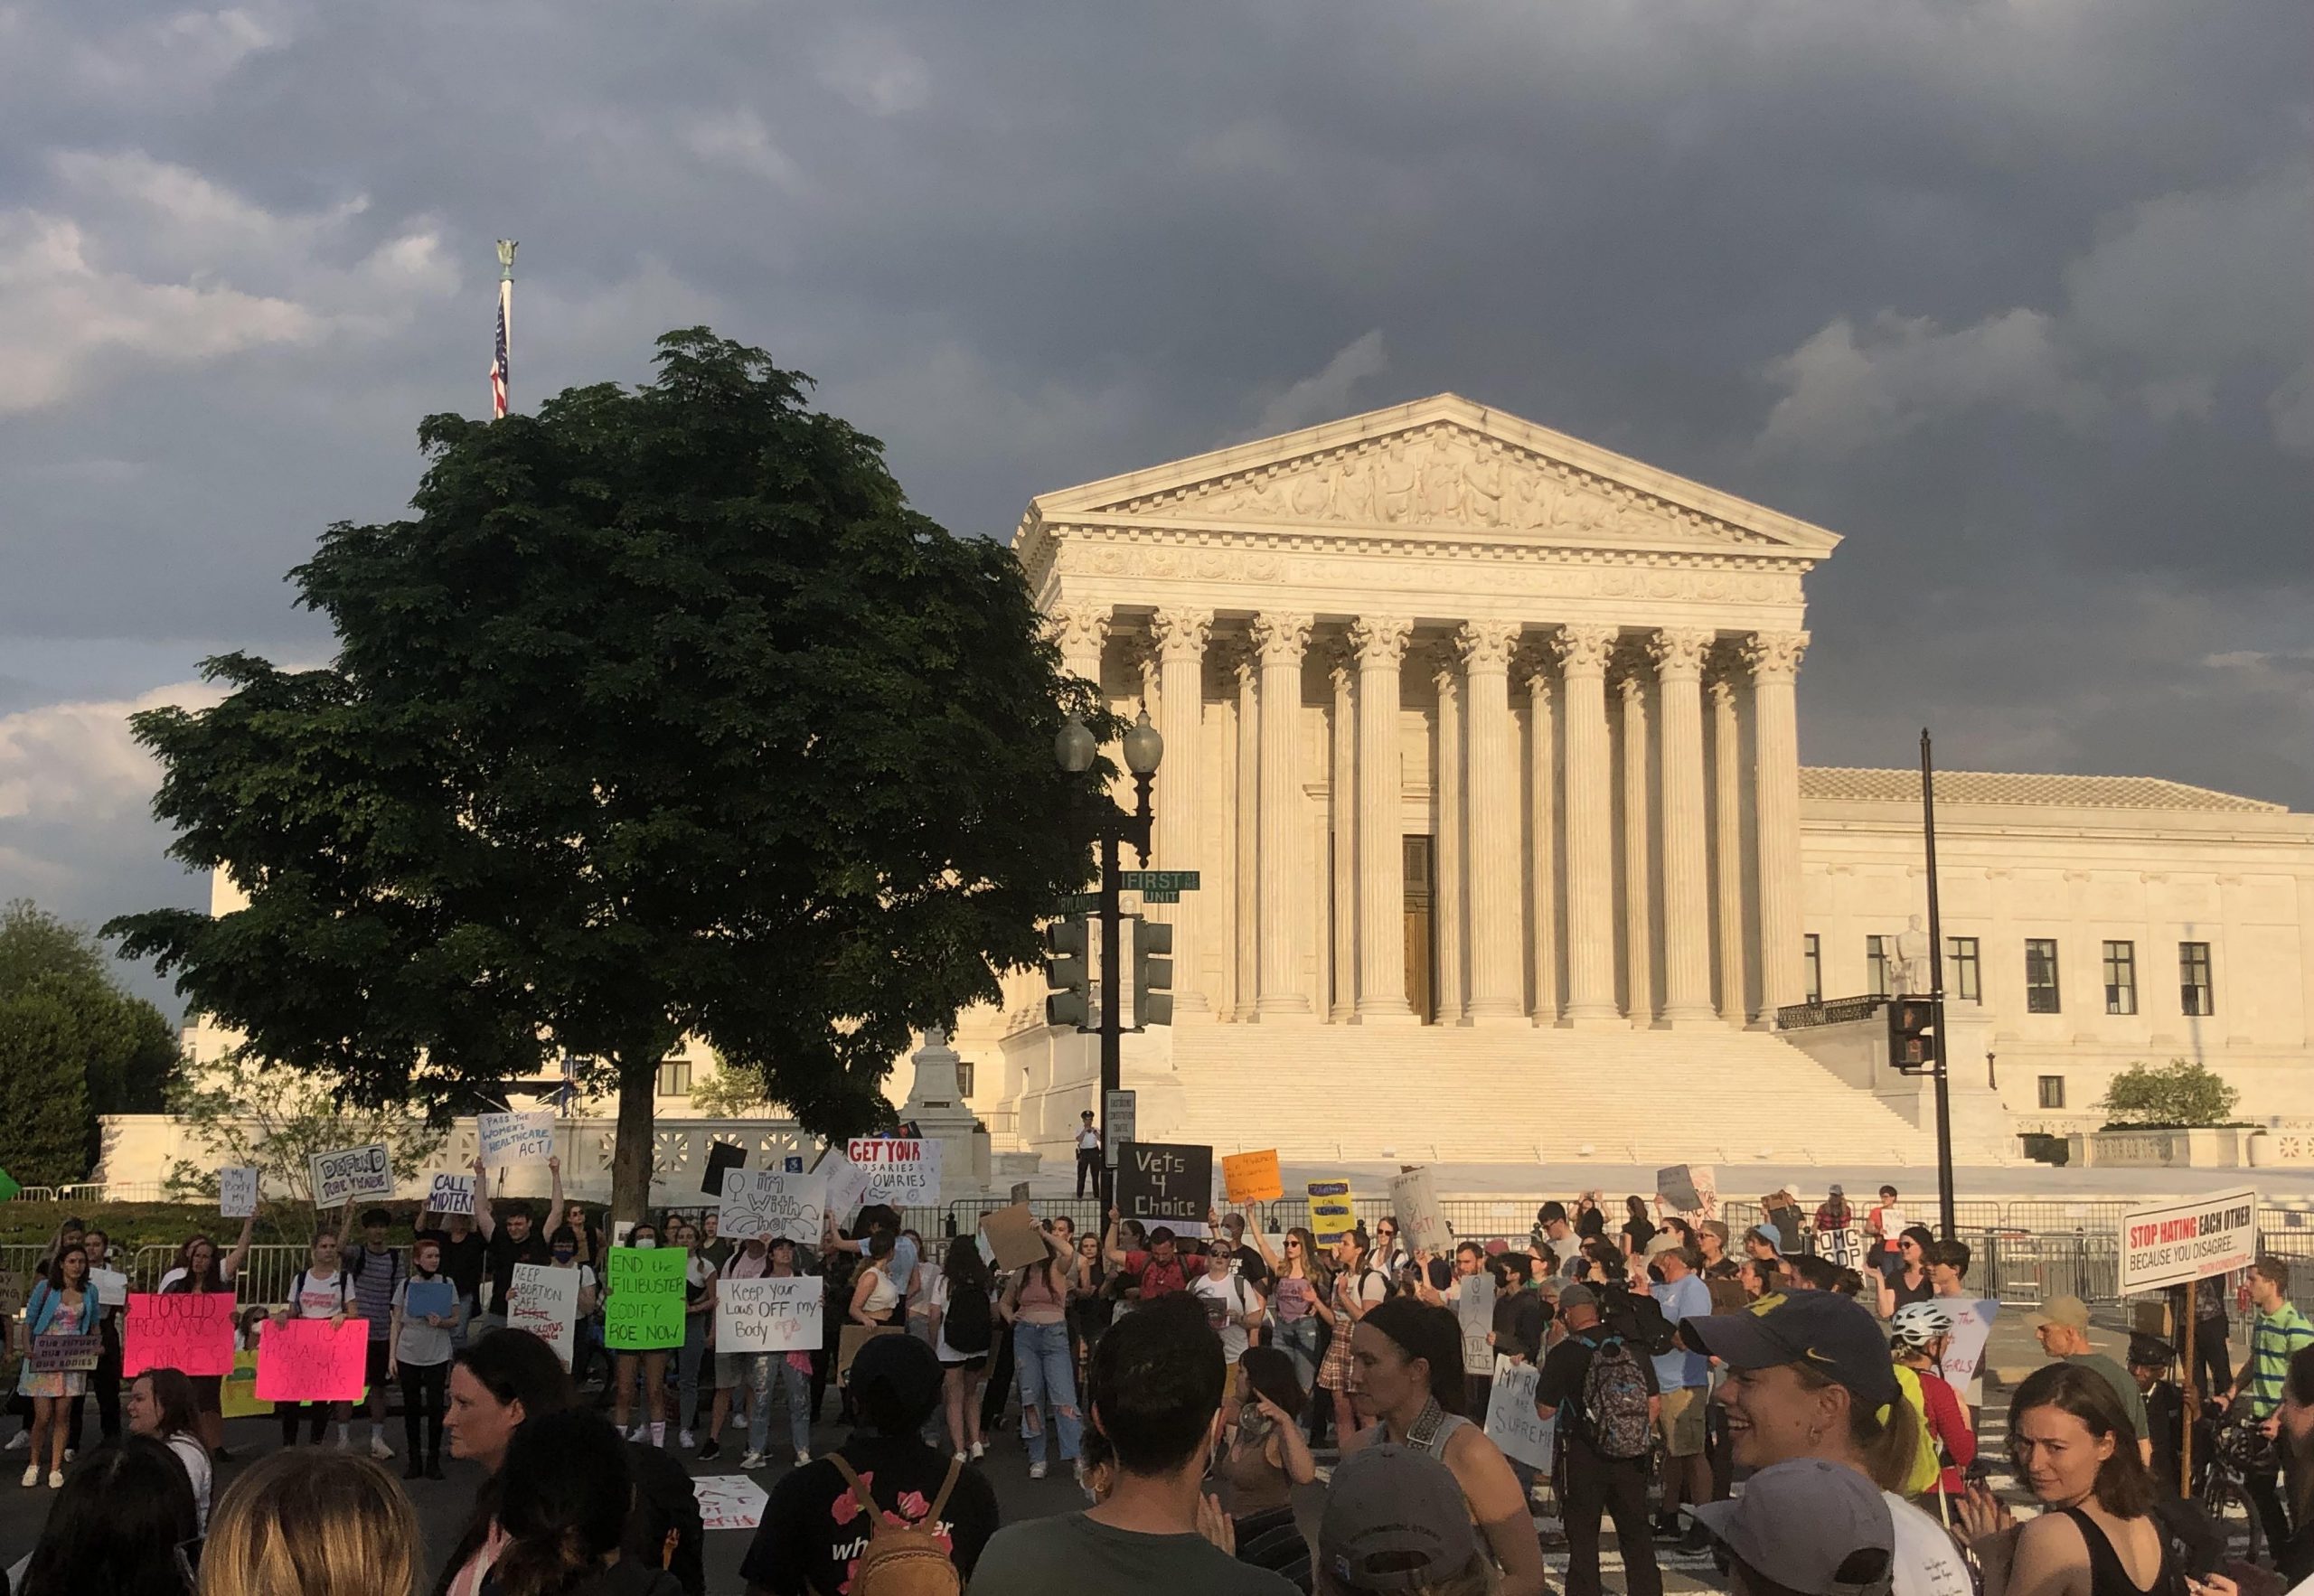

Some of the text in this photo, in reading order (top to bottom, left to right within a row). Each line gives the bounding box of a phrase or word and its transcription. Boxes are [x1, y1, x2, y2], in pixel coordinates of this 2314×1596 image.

[1129, 873, 1181, 888] FIRST
[1146, 892, 1178, 902] UNIT
[485, 1113, 530, 1128] PASS THE
[489, 1130, 550, 1154] HEALTHCARE
[850, 1141, 920, 1163] GET YOUR
[321, 1149, 386, 1179] DEFEND
[853, 1163, 914, 1173] OSARIES
[1135, 1151, 1184, 1172] Vets
[435, 1175, 468, 1192] CALL
[873, 1173, 926, 1188] OVARIES
[1152, 1175, 1165, 1197] 4
[1135, 1196, 1195, 1216] Choice
[2131, 1205, 2251, 1249] STOP HATING EACH OTHER
[1820, 1229, 1860, 1250] OMG
[612, 1254, 644, 1273] END
[2131, 1248, 2171, 1272] BECAUSE
[2173, 1245, 2191, 1263] YOU
[612, 1276, 684, 1293] FILIBUSTER
[732, 1283, 765, 1301] Keep
[608, 1302, 662, 1319] CODIFY
[759, 1301, 791, 1318] OFF
[608, 1322, 680, 1342] ROE NOW
[735, 1320, 768, 1346] Body
[1499, 1367, 1519, 1389] MY
